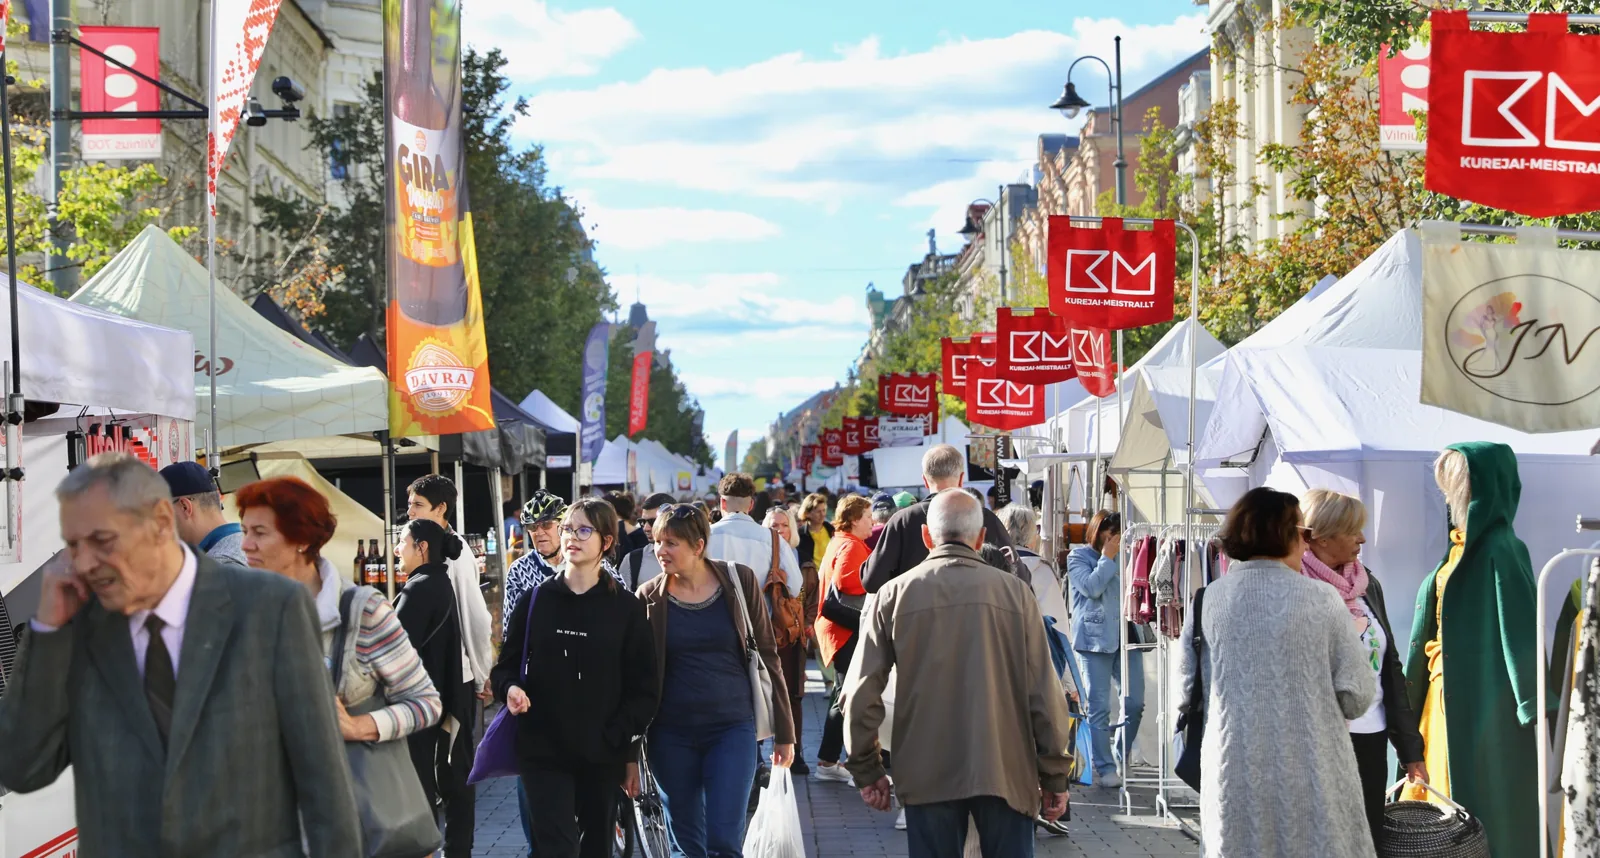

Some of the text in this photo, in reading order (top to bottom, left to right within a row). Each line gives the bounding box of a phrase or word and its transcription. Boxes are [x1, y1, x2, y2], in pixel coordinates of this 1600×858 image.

[398, 143, 450, 192] GIRA
[1064, 297, 1155, 308] KUREJAI-MEISTRAI.LT
[411, 372, 468, 388] DAVRA
